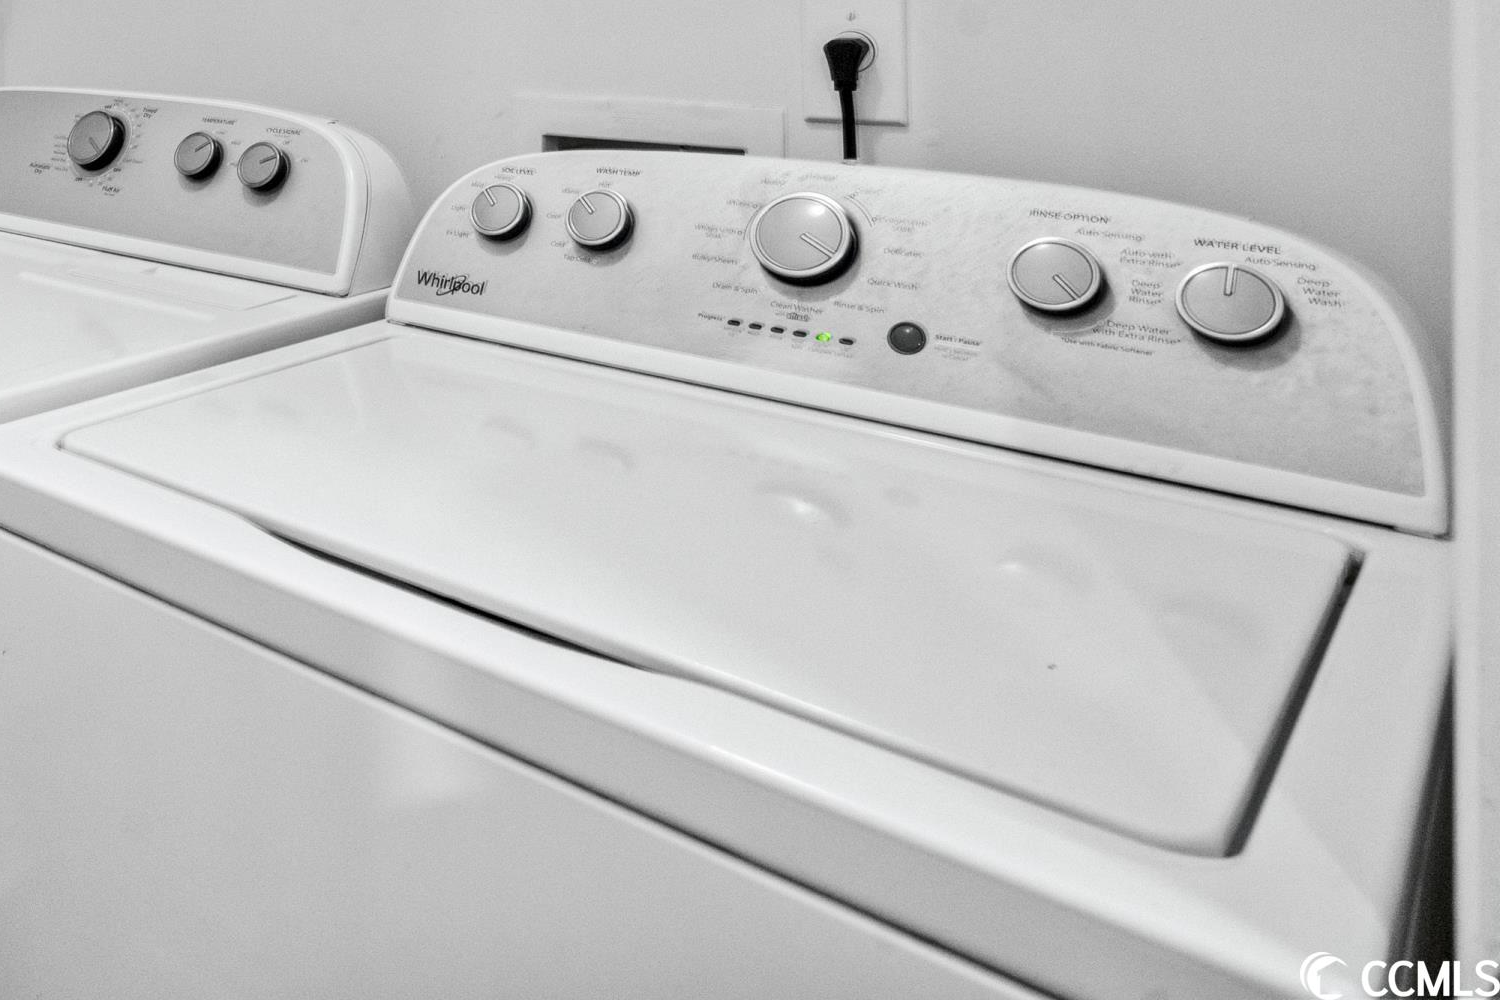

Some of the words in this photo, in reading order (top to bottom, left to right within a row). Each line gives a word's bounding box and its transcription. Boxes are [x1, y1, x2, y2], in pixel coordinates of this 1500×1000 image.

[202, 117, 236, 126] TEMPERATURE
[516, 168, 535, 176] LEVEL
[1029, 208, 1062, 219] RINSE
[1063, 212, 1109, 225] OPTION
[1075, 228, 1101, 236] Auto
[1102, 230, 1143, 242] Sensing
[1193, 238, 1239, 250] WATER
[1242, 243, 1282, 255] LEVEL
[1120, 248, 1146, 258] Auto
[1149, 250, 1173, 260] with
[1119, 257, 1145, 266] Extra
[1244, 256, 1271, 266] Auto
[1273, 258, 1317, 272] Sensing
[417, 269, 485, 297] Whirlpool
[712, 282, 732, 290] Drain
[740, 286, 758, 295] Spin
[867, 278, 893, 289] Quick
[895, 282, 918, 292] Wash
[1131, 279, 1161, 290] Deep
[1297, 276, 1331, 288] Deep
[1130, 288, 1163, 298] Water
[1302, 286, 1341, 298] Water
[770, 300, 793, 311] Clean
[793, 304, 824, 314] Washer
[833, 300, 854, 310] Rinse
[863, 306, 885, 315] Spin
[1308, 297, 1344, 308] Wash
[1106, 319, 1136, 330] Deep
[1138, 324, 1171, 335] Water
[1092, 326, 1116, 337] with
[1118, 332, 1146, 342] Extra
[958, 338, 981, 346] Pause
[1078, 339, 1094, 348] with
[1122, 345, 1153, 356] Softener
